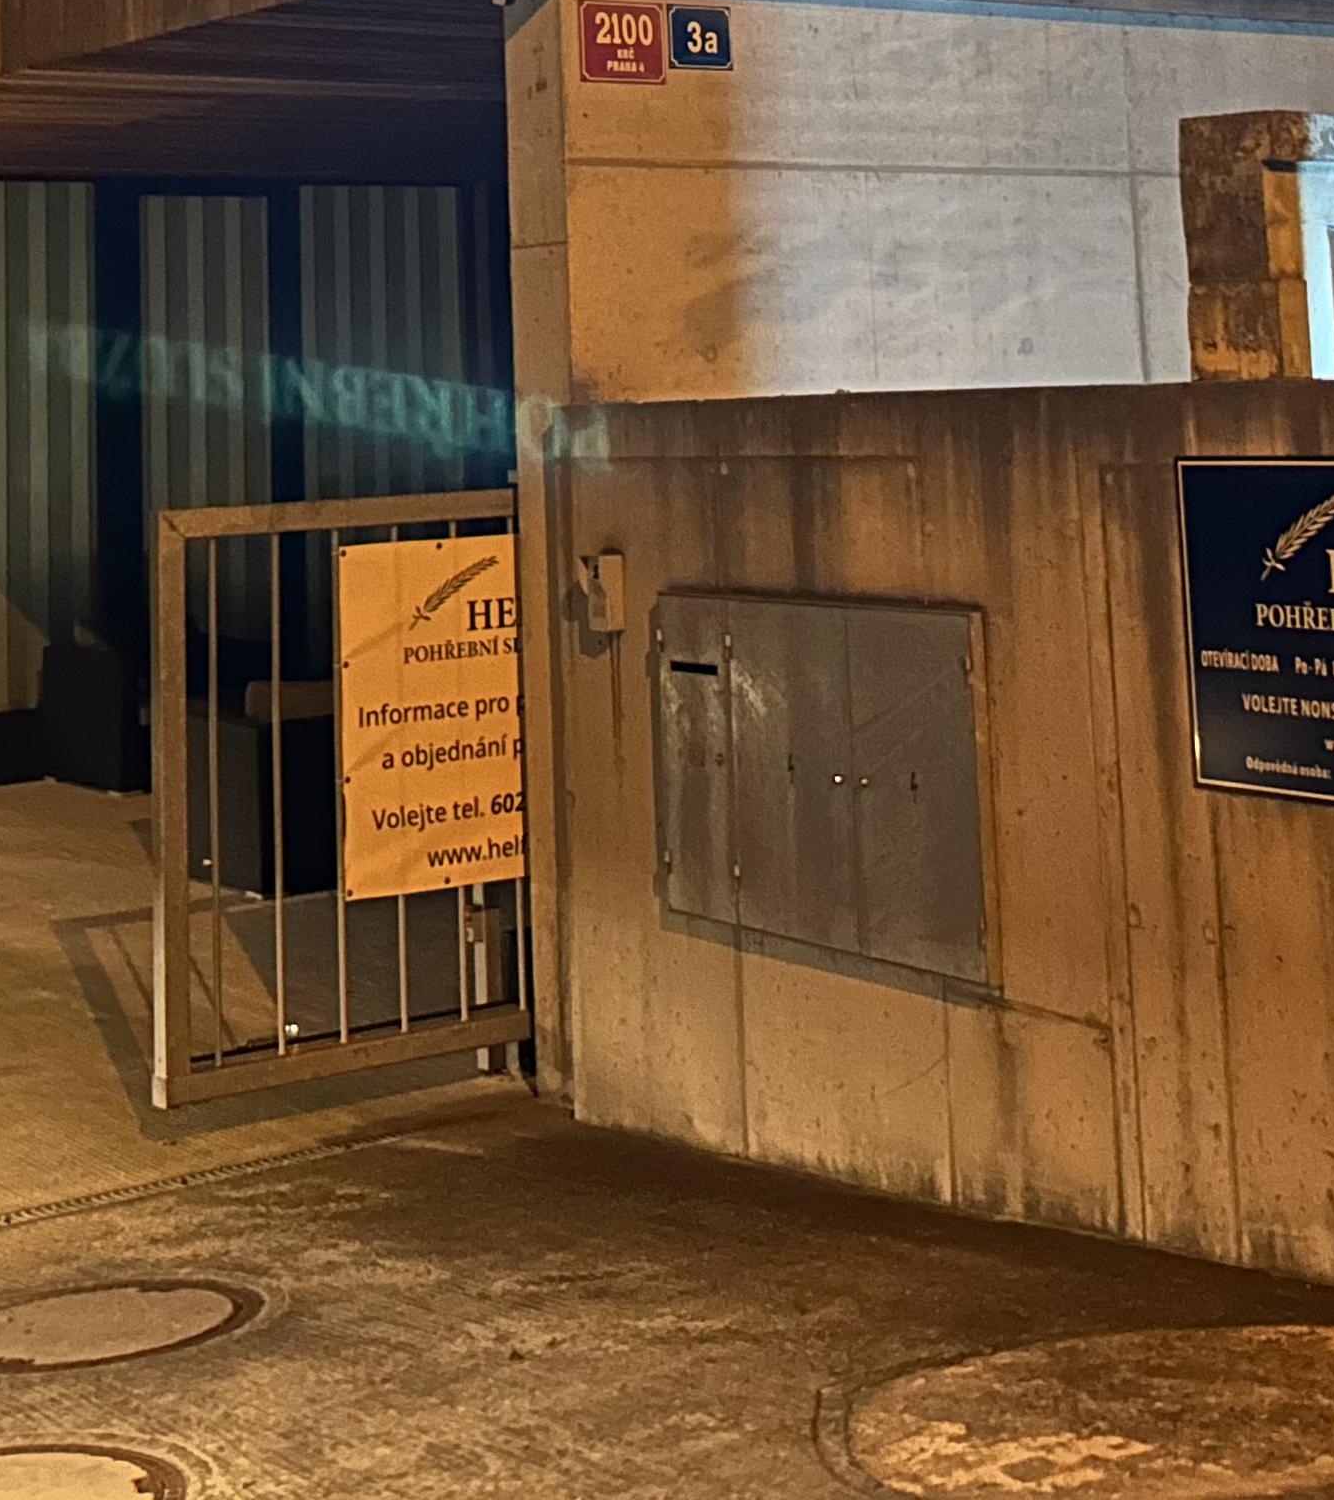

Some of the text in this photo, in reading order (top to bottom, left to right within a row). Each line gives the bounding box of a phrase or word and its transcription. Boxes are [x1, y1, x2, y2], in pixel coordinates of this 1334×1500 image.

[595, 11, 653, 46] 2100
[687, 21, 718, 53] 3a
[403, 635, 499, 664] POHŘEBNÍ
[1200, 648, 1250, 670] OTEVÍRACÍ
[1251, 652, 1279, 673] DOBA
[358, 699, 469, 728] Informace
[475, 695, 509, 721] pro
[1242, 693, 1298, 717] VOLEJTE
[381, 751, 395, 770] a
[401, 733, 507, 772] objednání
[372, 805, 447, 833] Volejte
[453, 795, 485, 821] tel.
